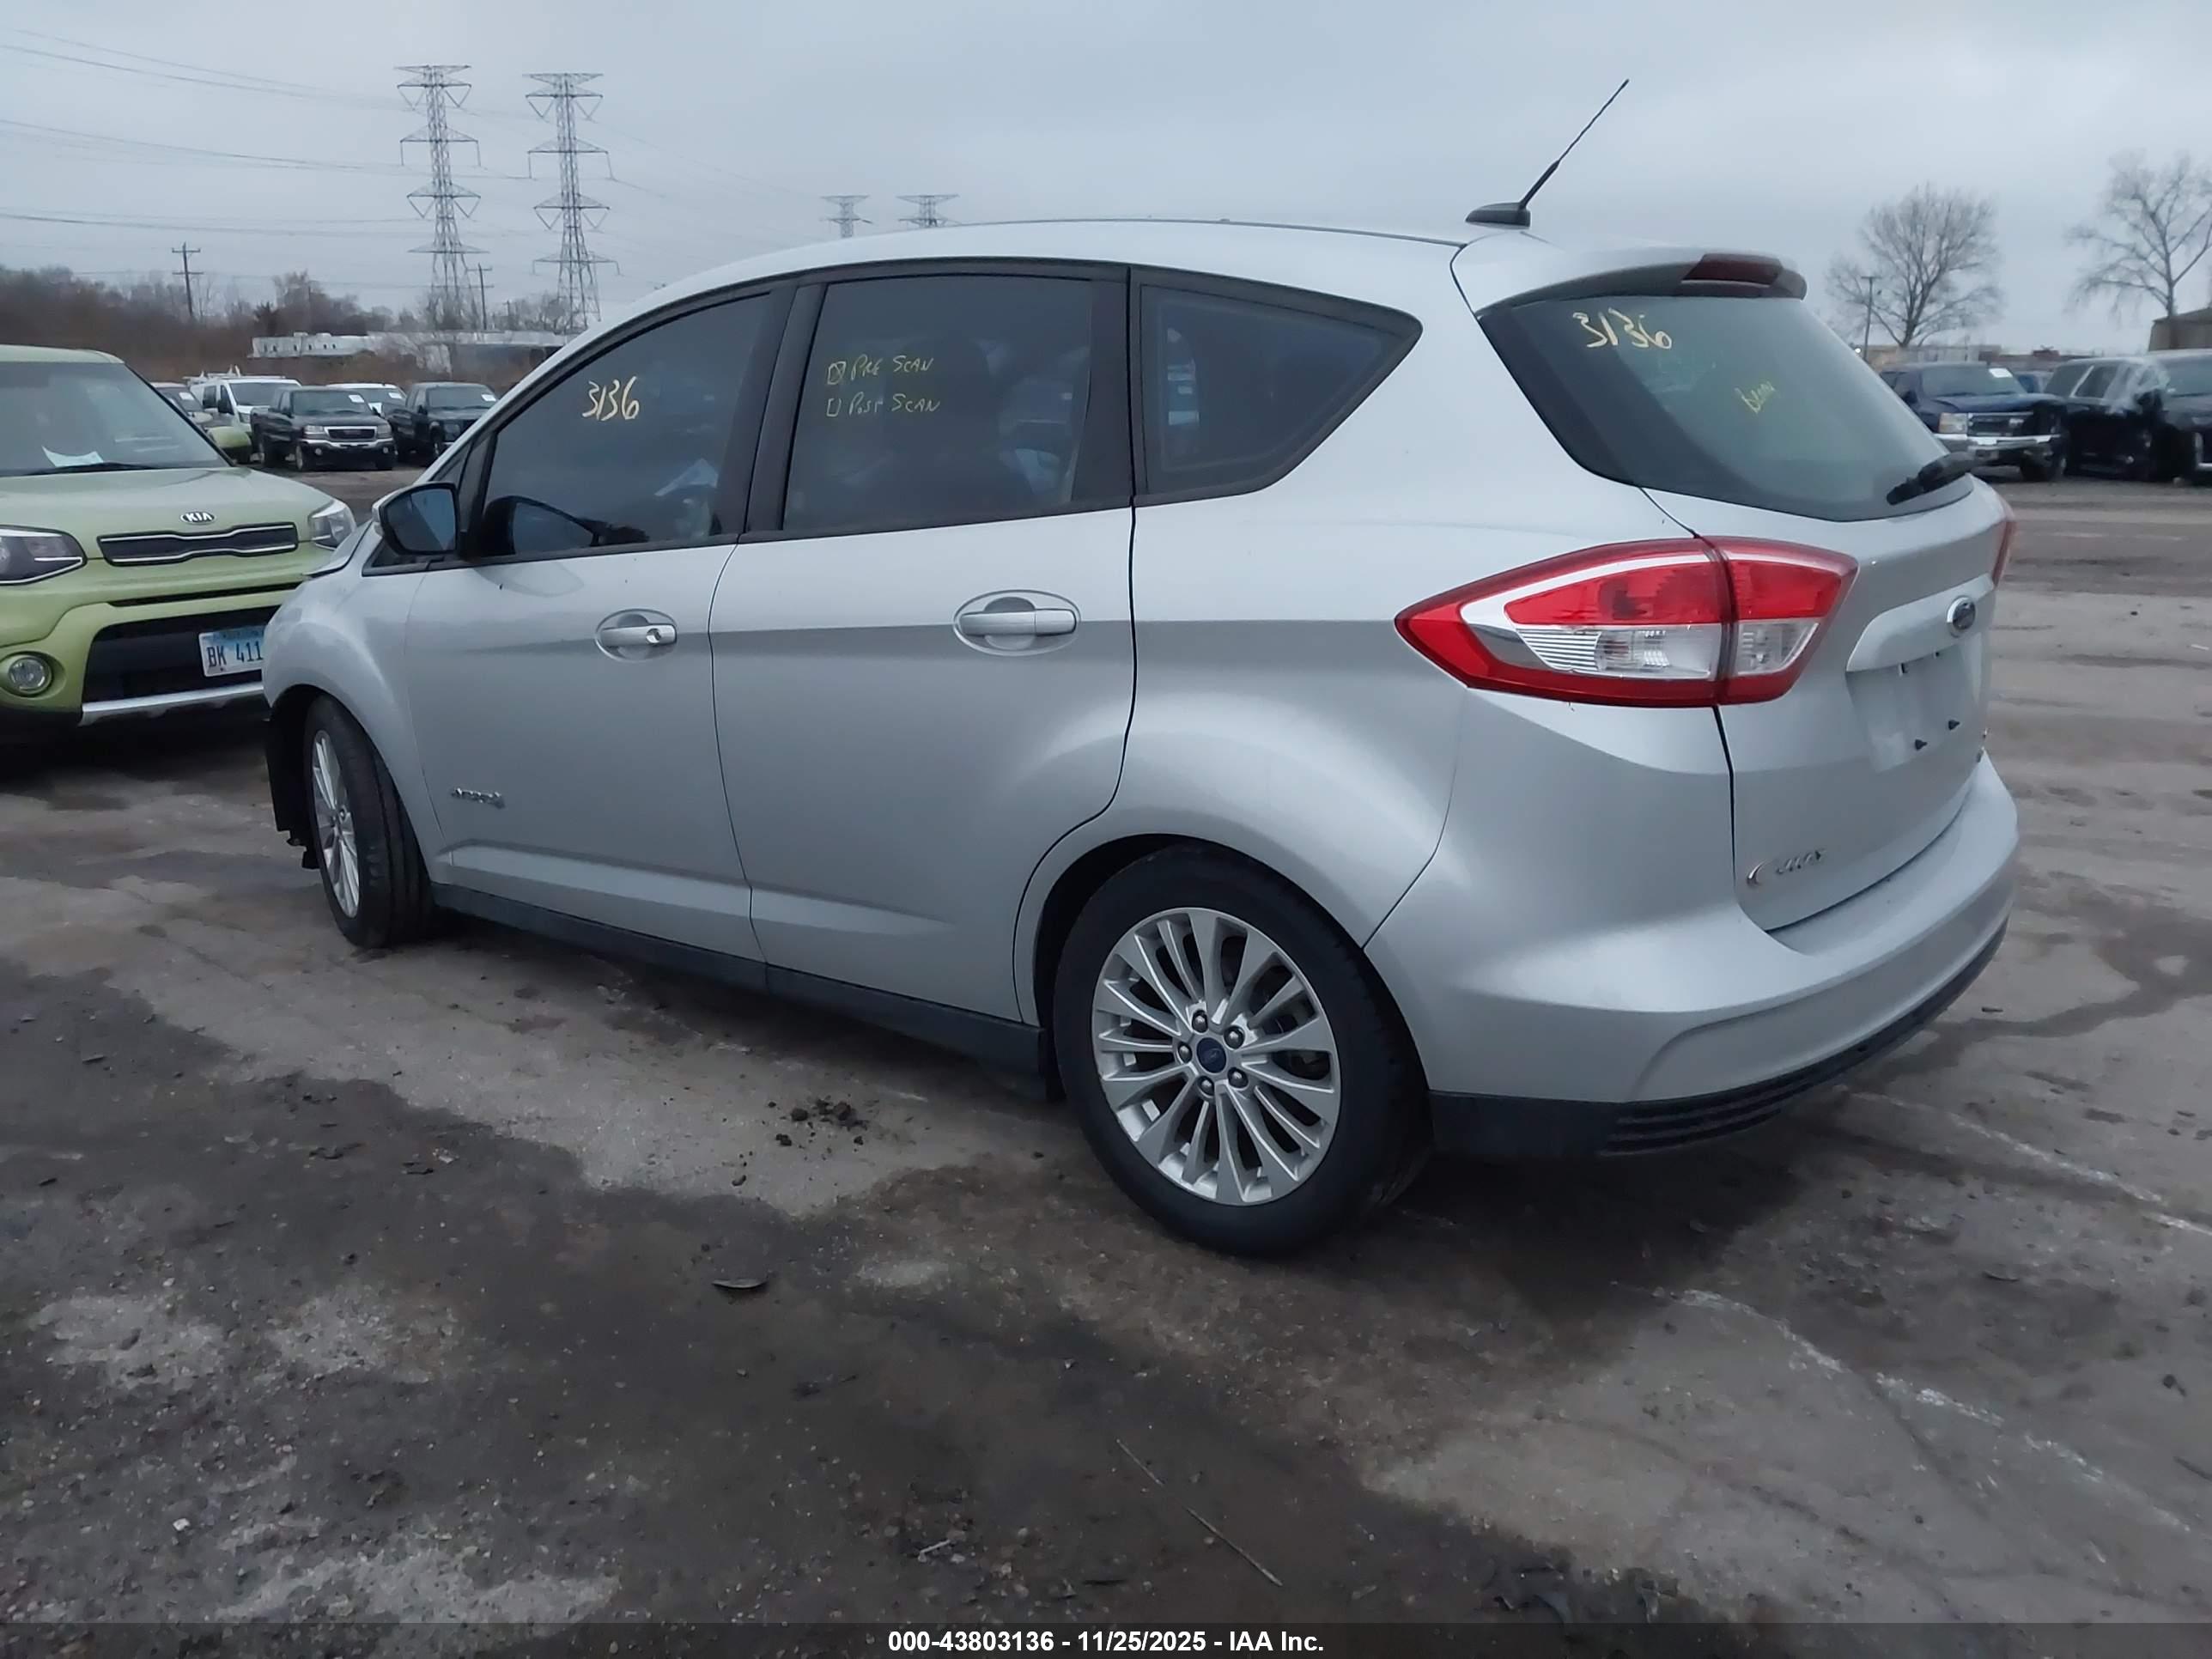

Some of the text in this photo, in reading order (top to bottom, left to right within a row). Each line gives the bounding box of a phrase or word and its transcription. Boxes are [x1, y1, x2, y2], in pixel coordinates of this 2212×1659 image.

[1572, 307, 1672, 349] 3136
[582, 376, 640, 421] 3136
[185, 512, 213, 522] KIA
[207, 645, 227, 667] BK
